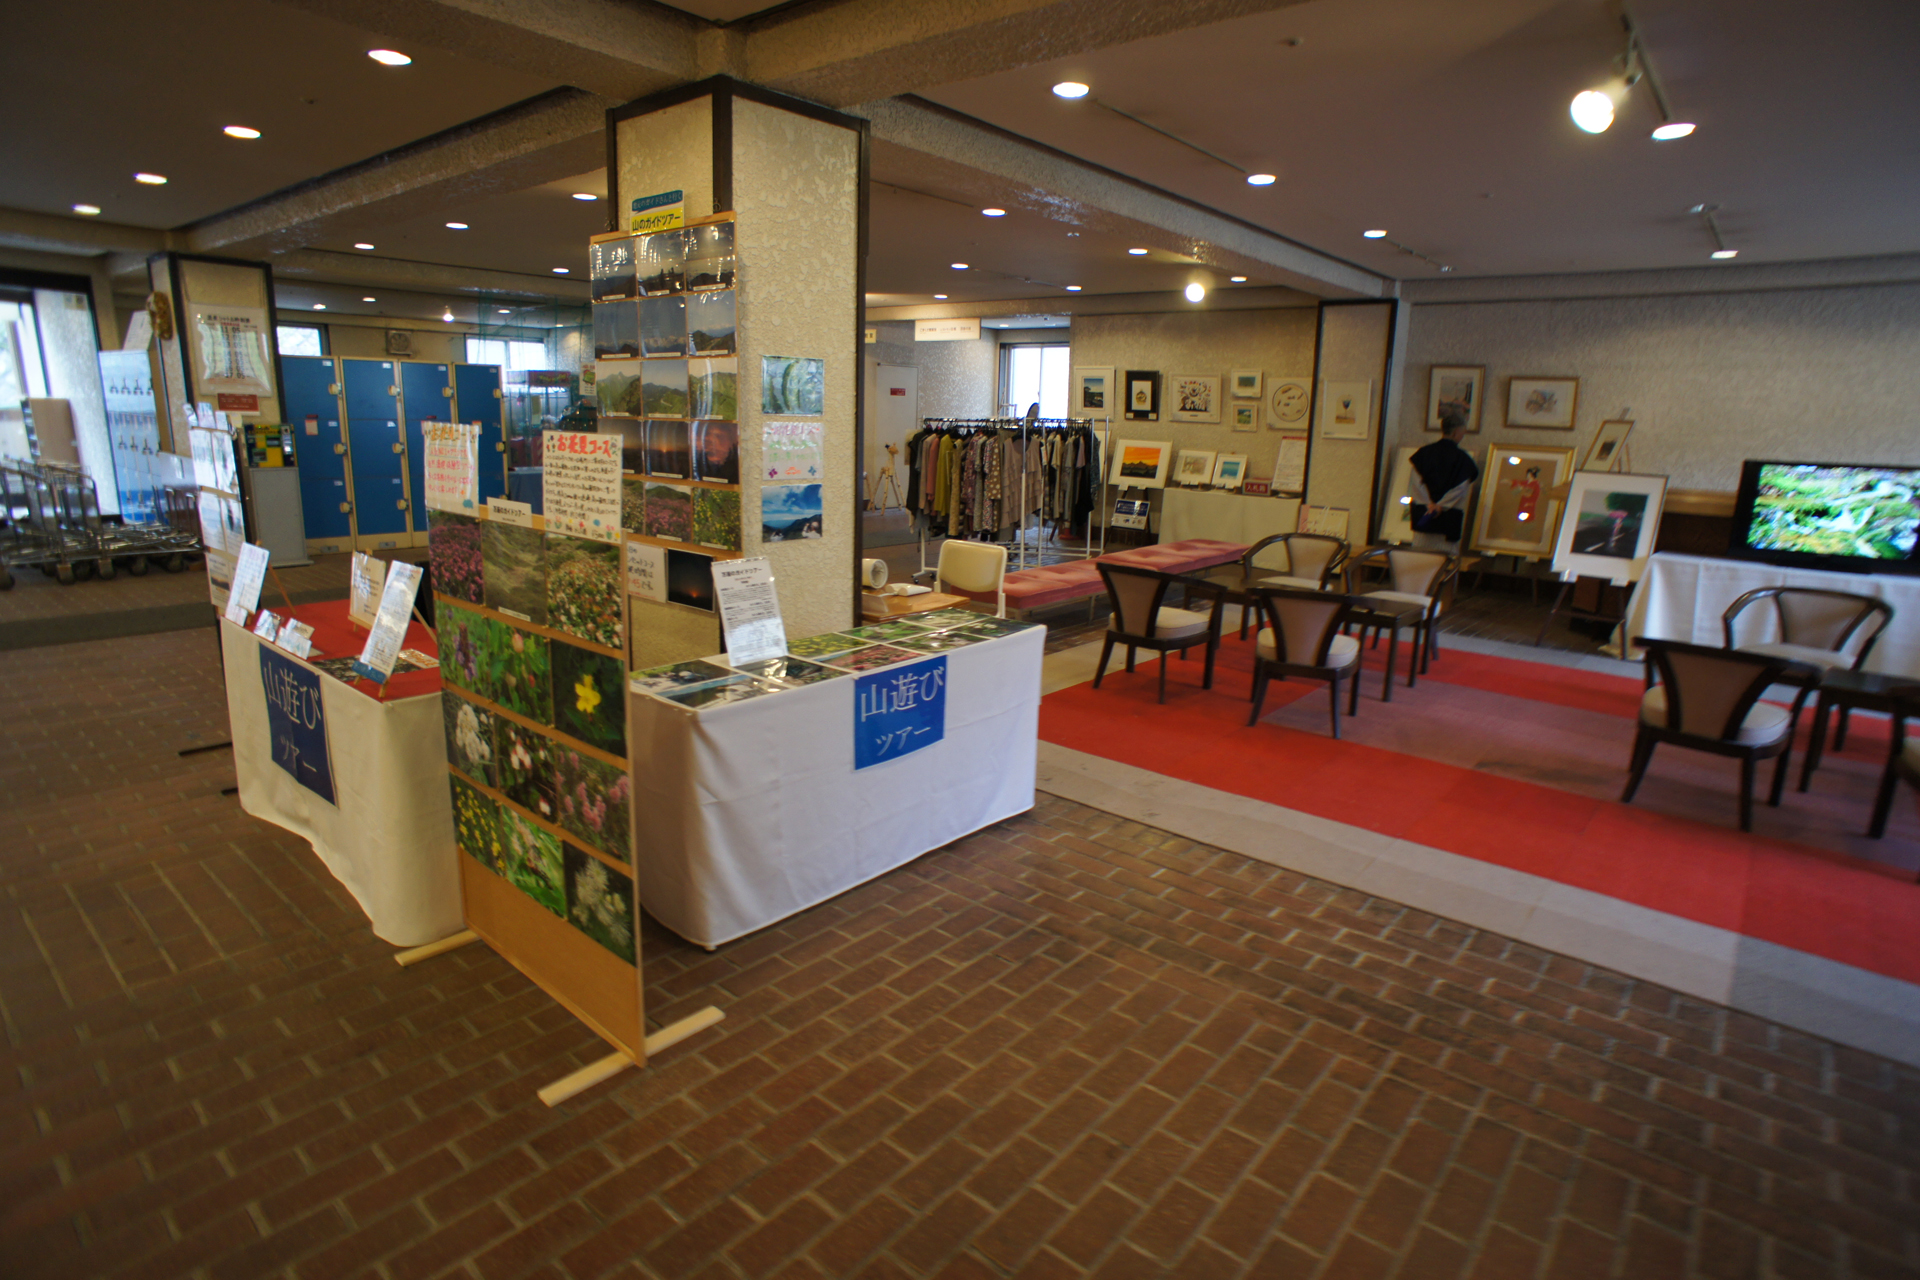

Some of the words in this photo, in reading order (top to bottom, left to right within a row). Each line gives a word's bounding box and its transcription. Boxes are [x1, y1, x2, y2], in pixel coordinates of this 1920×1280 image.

[632, 213, 681, 231] 山のガイドツアー
[557, 434, 611, 458] お花見コース
[263, 662, 323, 731] 山遊び
[861, 666, 945, 722] 山遊び
[280, 735, 318, 774] ツアー
[875, 726, 932, 757] ツアー
